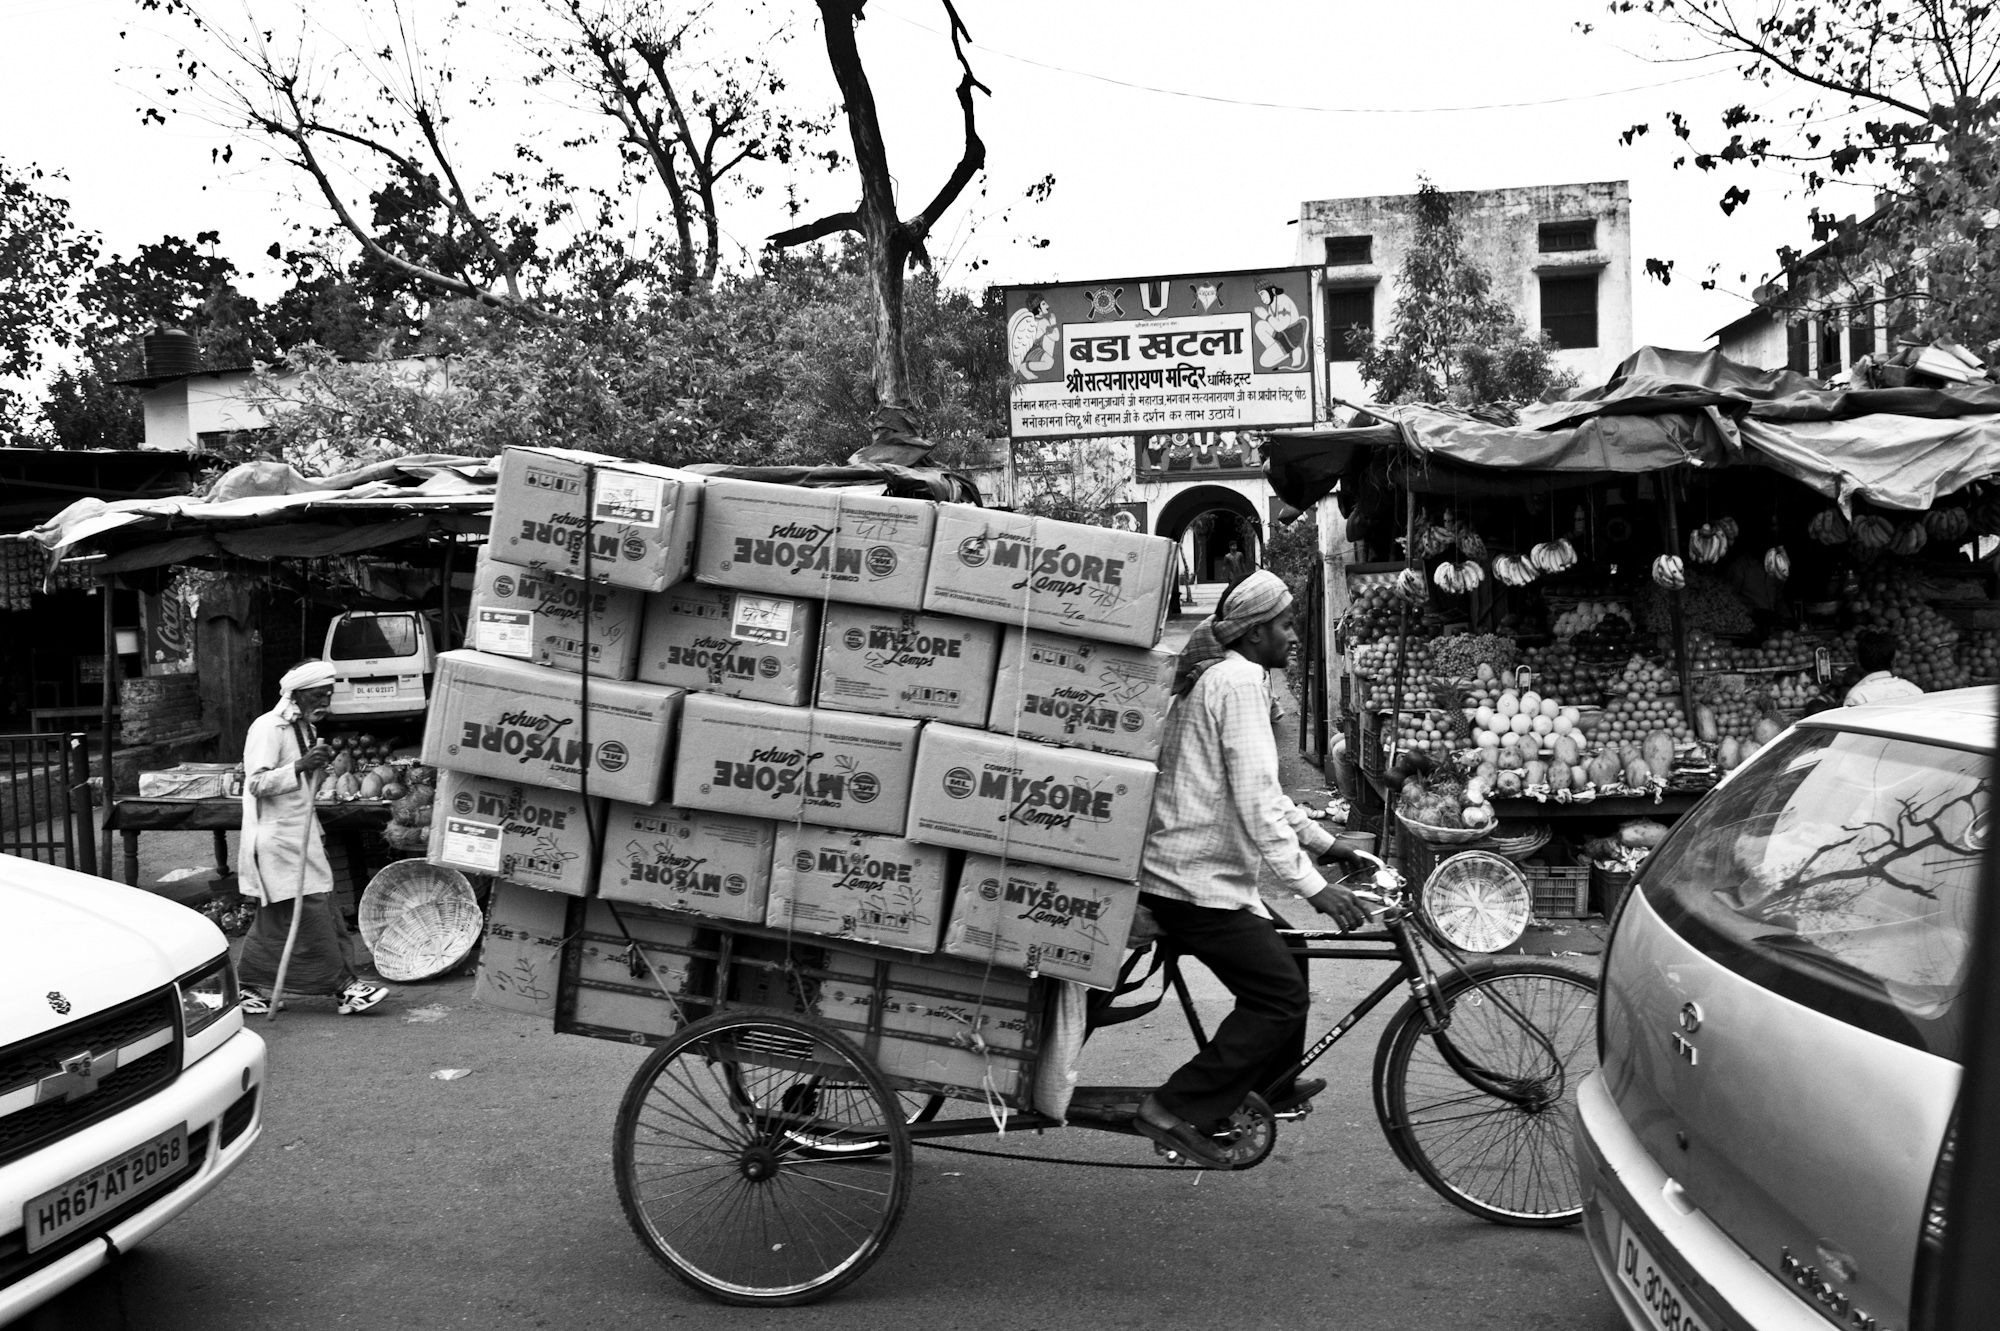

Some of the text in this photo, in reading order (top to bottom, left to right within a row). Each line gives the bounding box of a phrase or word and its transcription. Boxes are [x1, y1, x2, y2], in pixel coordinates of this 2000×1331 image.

[1069, 328, 1244, 363] बडा खटला
[1084, 369, 1164, 392] सत्यनारायण
[1165, 362, 1207, 389] मन्दिर
[1247, 390, 1257, 401] का
[1021, 414, 1063, 429] मनोकामना
[1094, 413, 1121, 427] हनुमान
[1122, 409, 1132, 424] जी
[1132, 408, 1140, 422] के
[1142, 408, 1166, 423] दर्शन
[1168, 410, 1182, 421] कर
[1184, 410, 1205, 421] लाभ
[768, 522, 842, 557] Lamps
[999, 532, 1031, 543] COMPAC
[733, 537, 863, 575] MYSORE
[992, 541, 1125, 586] MYSORE
[1011, 562, 1087, 598] Lamps
[531, 597, 583, 621] Lamps
[667, 645, 757, 676] MYSORE
[691, 636, 743, 662] Lamps
[882, 642, 937, 669] Lamps
[1023, 694, 1119, 729] MYSORE
[1051, 687, 1106, 714] Lamps
[497, 710, 574, 747] Lamps
[460, 721, 594, 769] MYSORE
[603, 753, 622, 761] ML
[550, 764, 588, 776] OMPACT
[749, 746, 825, 781] Lamps
[984, 763, 1024, 776] COMPACT
[712, 760, 846, 801] MYSORE
[949, 778, 969, 788] ML
[978, 771, 1114, 819] MYSORE
[803, 798, 842, 808] COMPACT
[997, 795, 1076, 830] Lamps
[629, 862, 722, 893] MYSORE
[654, 853, 708, 878] Lamps
[831, 867, 886, 893] Lamps
[1004, 882, 1102, 922] MYSORE
[1017, 900, 1074, 927] Lamps
[1301, 1026, 1342, 1066] NEELAM
[1625, 1238, 1641, 1288] DL
